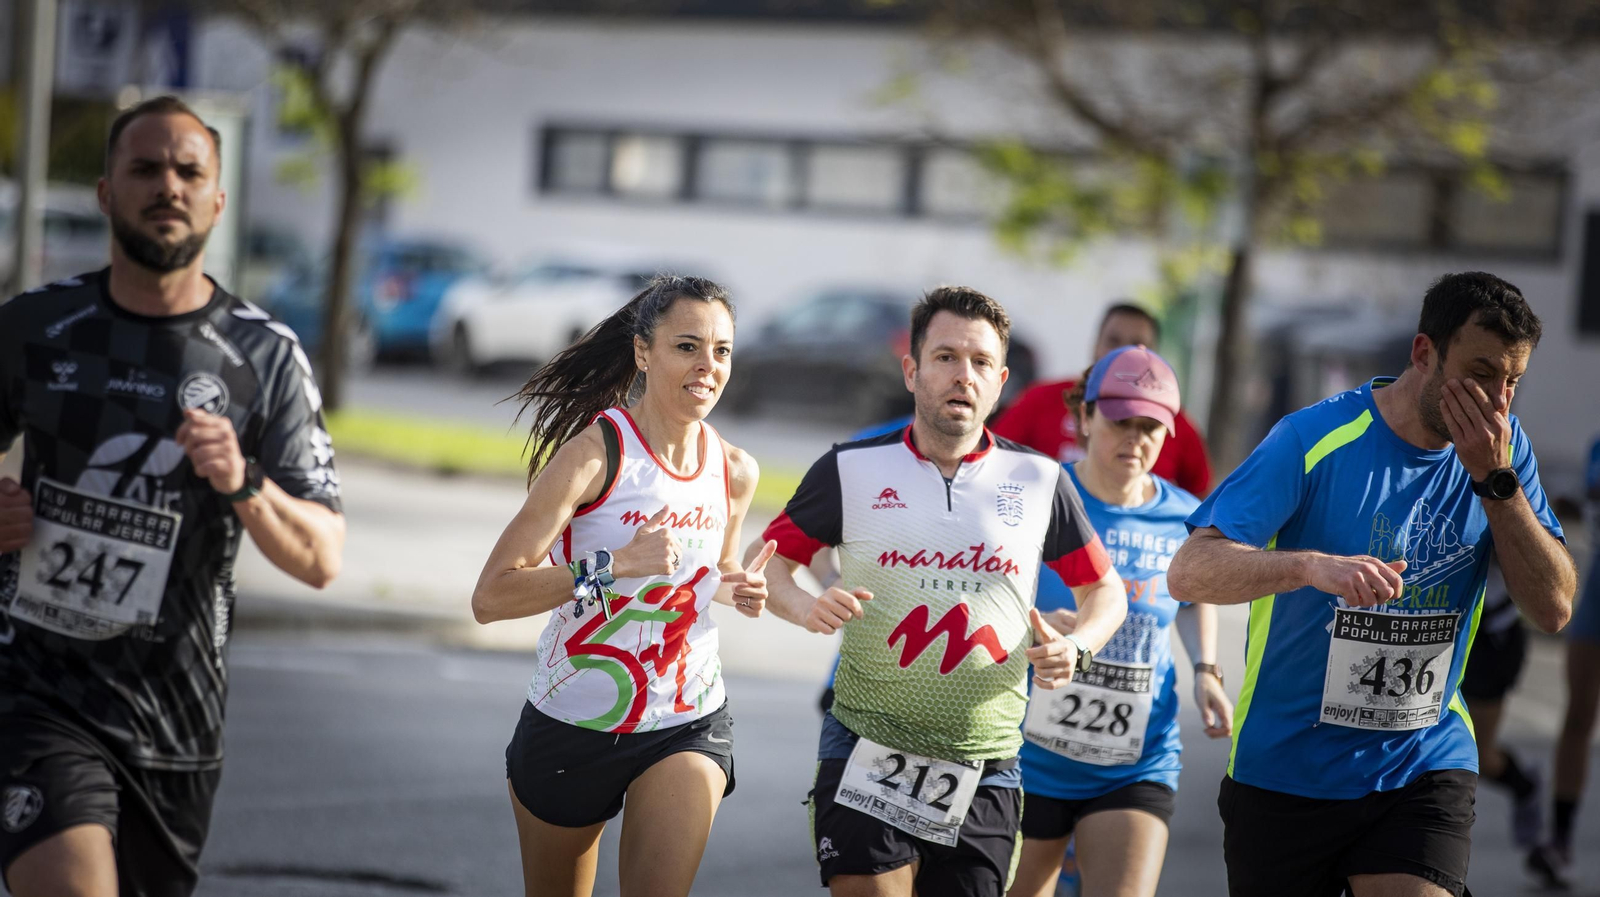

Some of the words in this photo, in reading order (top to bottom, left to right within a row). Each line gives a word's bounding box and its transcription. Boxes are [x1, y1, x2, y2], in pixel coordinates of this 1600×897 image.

[82, 501, 172, 533] CARRERA
[109, 523, 169, 547] JEREZ
[1106, 528, 1184, 554] CARRER
[877, 542, 1019, 575] maratón
[46, 541, 146, 606] 247
[919, 578, 982, 593] JEREZ
[1340, 626, 1408, 643] POPULAR
[1413, 631, 1451, 643] JEREZ
[1342, 614, 1373, 627] XLV
[1391, 618, 1453, 630] CARRERA
[1108, 679, 1148, 692] JEREZ
[1359, 655, 1439, 698] 436
[1058, 694, 1133, 737] 228
[1323, 705, 1358, 723] enjoy!
[876, 753, 959, 812] 212
[839, 787, 872, 808] enjoy!
